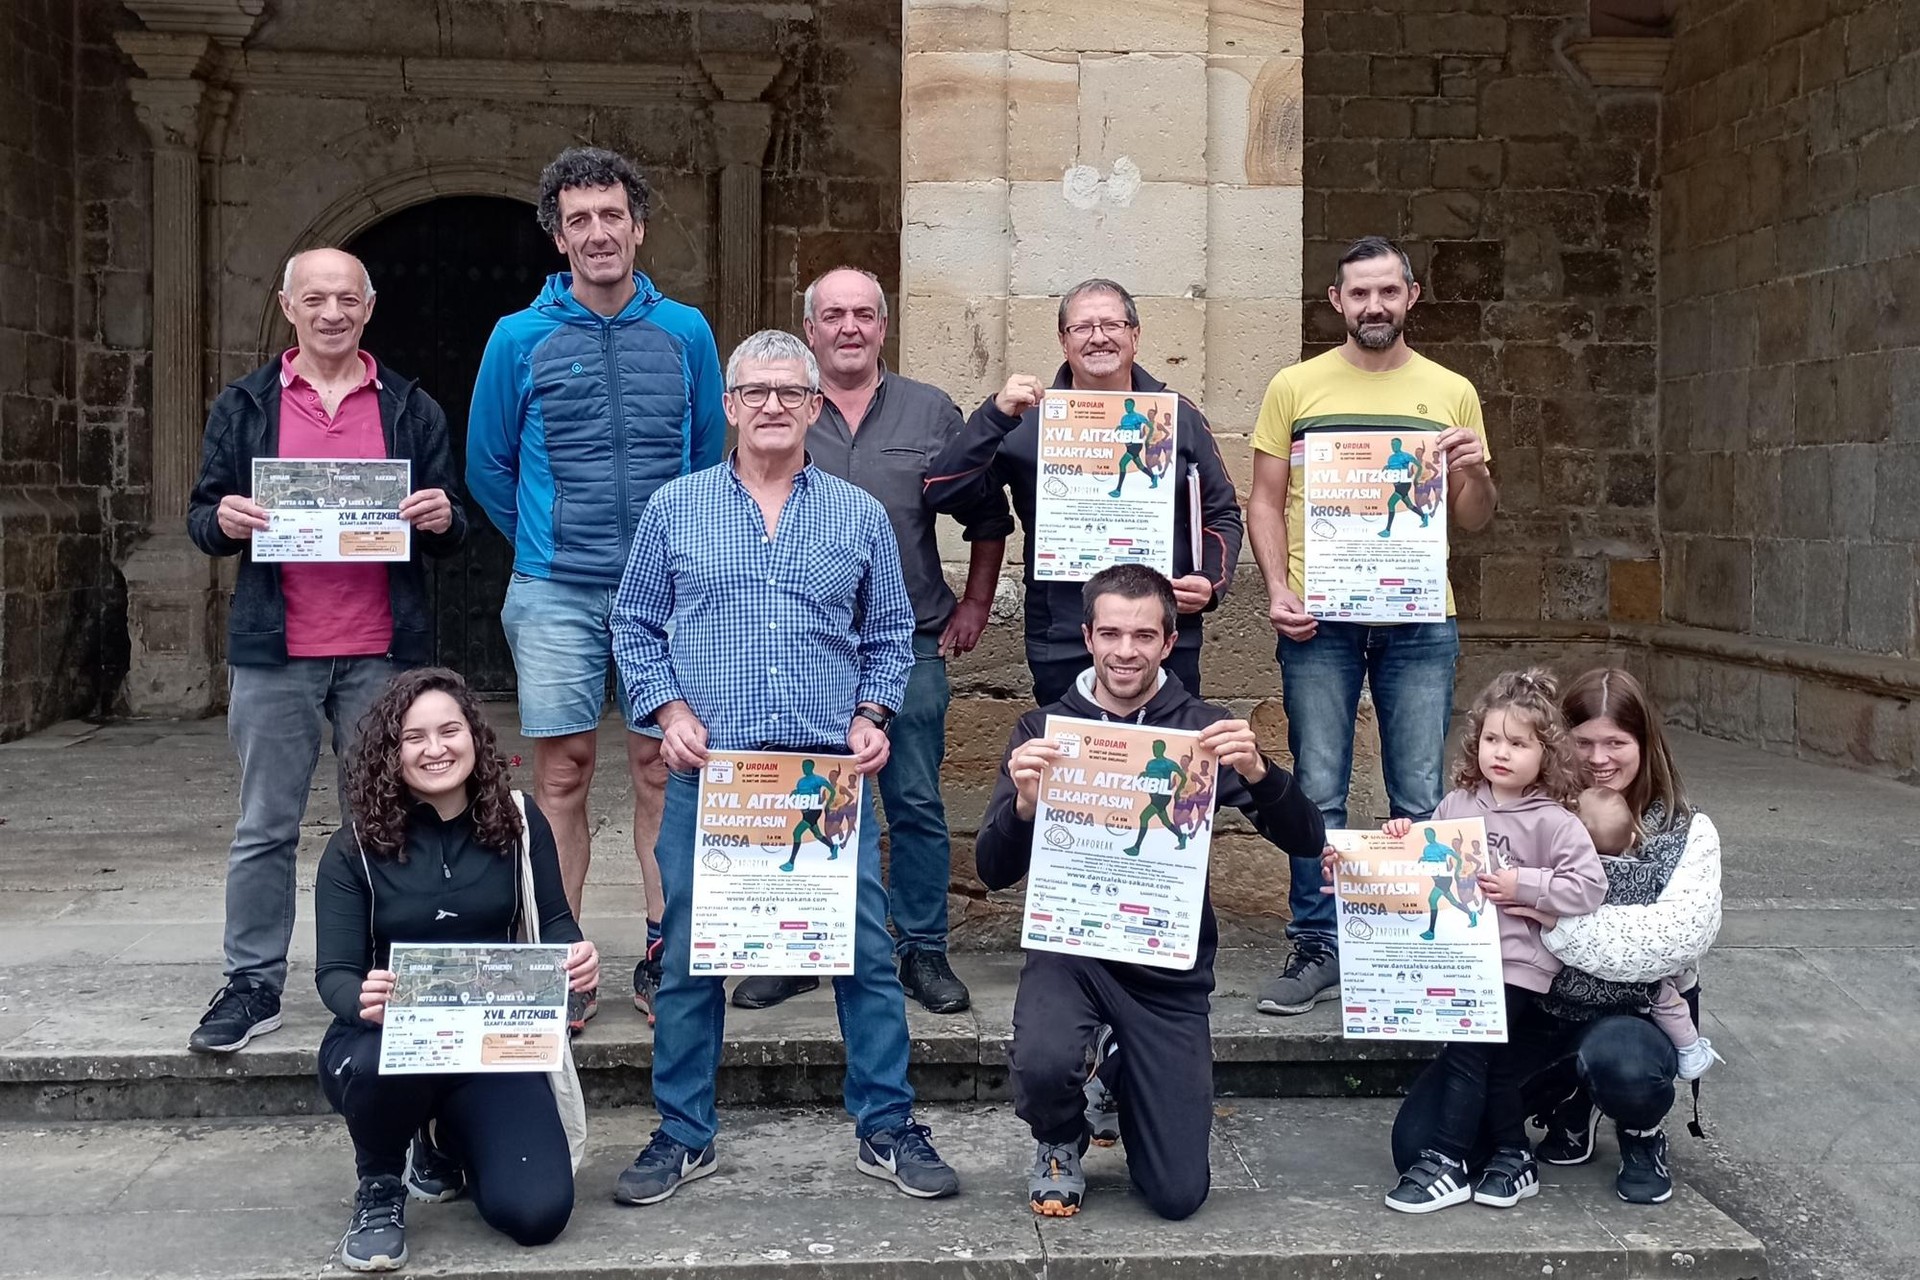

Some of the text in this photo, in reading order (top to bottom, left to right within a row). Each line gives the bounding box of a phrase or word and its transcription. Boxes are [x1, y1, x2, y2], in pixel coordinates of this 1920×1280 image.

[1077, 401, 1104, 409] URDIAIN
[1043, 447, 1113, 459] ELKARTASUN
[1043, 463, 1083, 476] KROSA
[1310, 488, 1381, 500] ELKARTASUN
[361, 512, 402, 520] AITZKIBI
[1310, 505, 1351, 517] KROSA
[1093, 738, 1127, 749] URDIAIN
[746, 763, 778, 771] URDIAIN
[1047, 788, 1134, 810] ELKARTASUN
[703, 815, 787, 828] ELKARTASUN
[1044, 808, 1095, 827] KROSA
[702, 833, 750, 848] KROSA
[1076, 837, 1114, 850] ZAPOREAK
[1487, 832, 1511, 851] SA
[1340, 882, 1421, 896] ELKARTASUN
[1342, 901, 1388, 916] KROSA
[1374, 926, 1410, 937] ZAPOREAK
